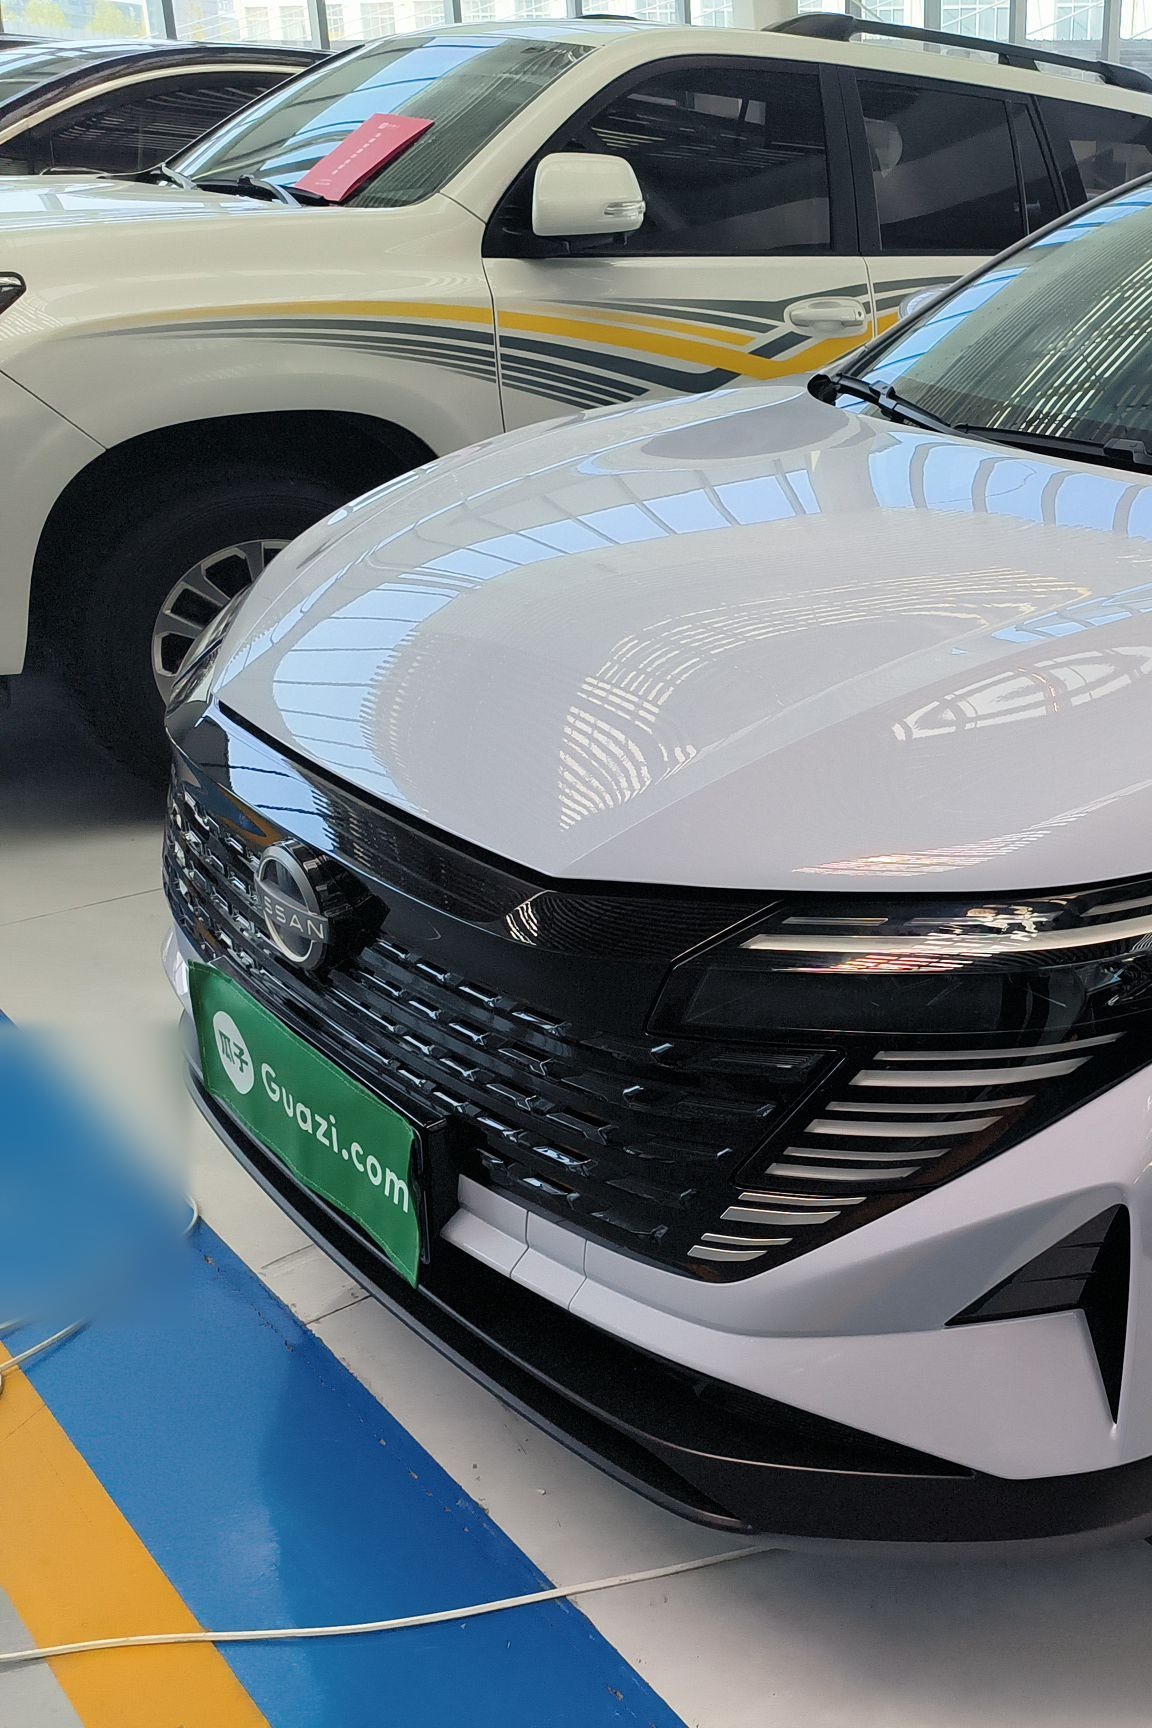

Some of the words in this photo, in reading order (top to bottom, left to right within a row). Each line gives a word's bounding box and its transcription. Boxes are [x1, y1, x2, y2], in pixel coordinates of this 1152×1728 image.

[261, 894, 326, 939] SSAN
[219, 1029, 249, 1073] 瓜子
[261, 1062, 409, 1213] Guazi.com
